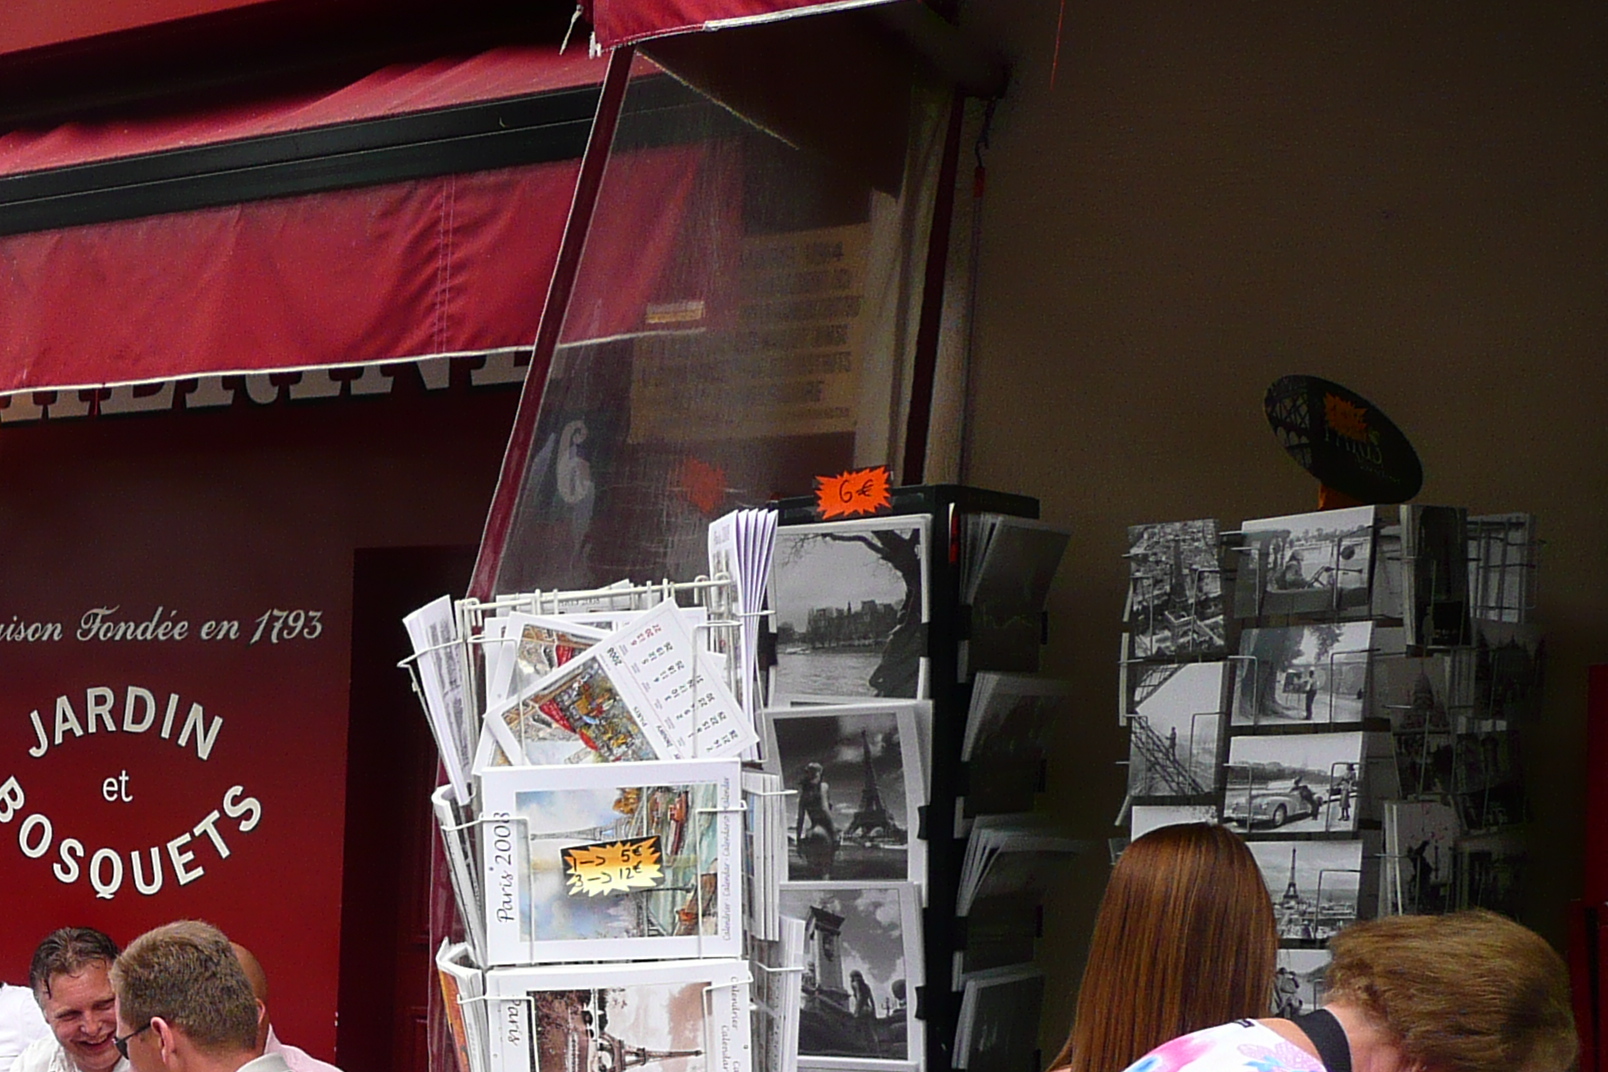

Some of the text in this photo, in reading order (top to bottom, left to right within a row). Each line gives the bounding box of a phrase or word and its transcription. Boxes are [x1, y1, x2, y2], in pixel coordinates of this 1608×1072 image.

[76, 605, 188, 642] Fondée
[200, 620, 240, 642] en
[250, 607, 324, 645] 1793
[28, 684, 224, 761] JARDIN
[654, 723, 673, 748] January
[102, 769, 133, 802] et
[496, 869, 515, 923] Paris
[722, 1024, 733, 1072] Calendar
